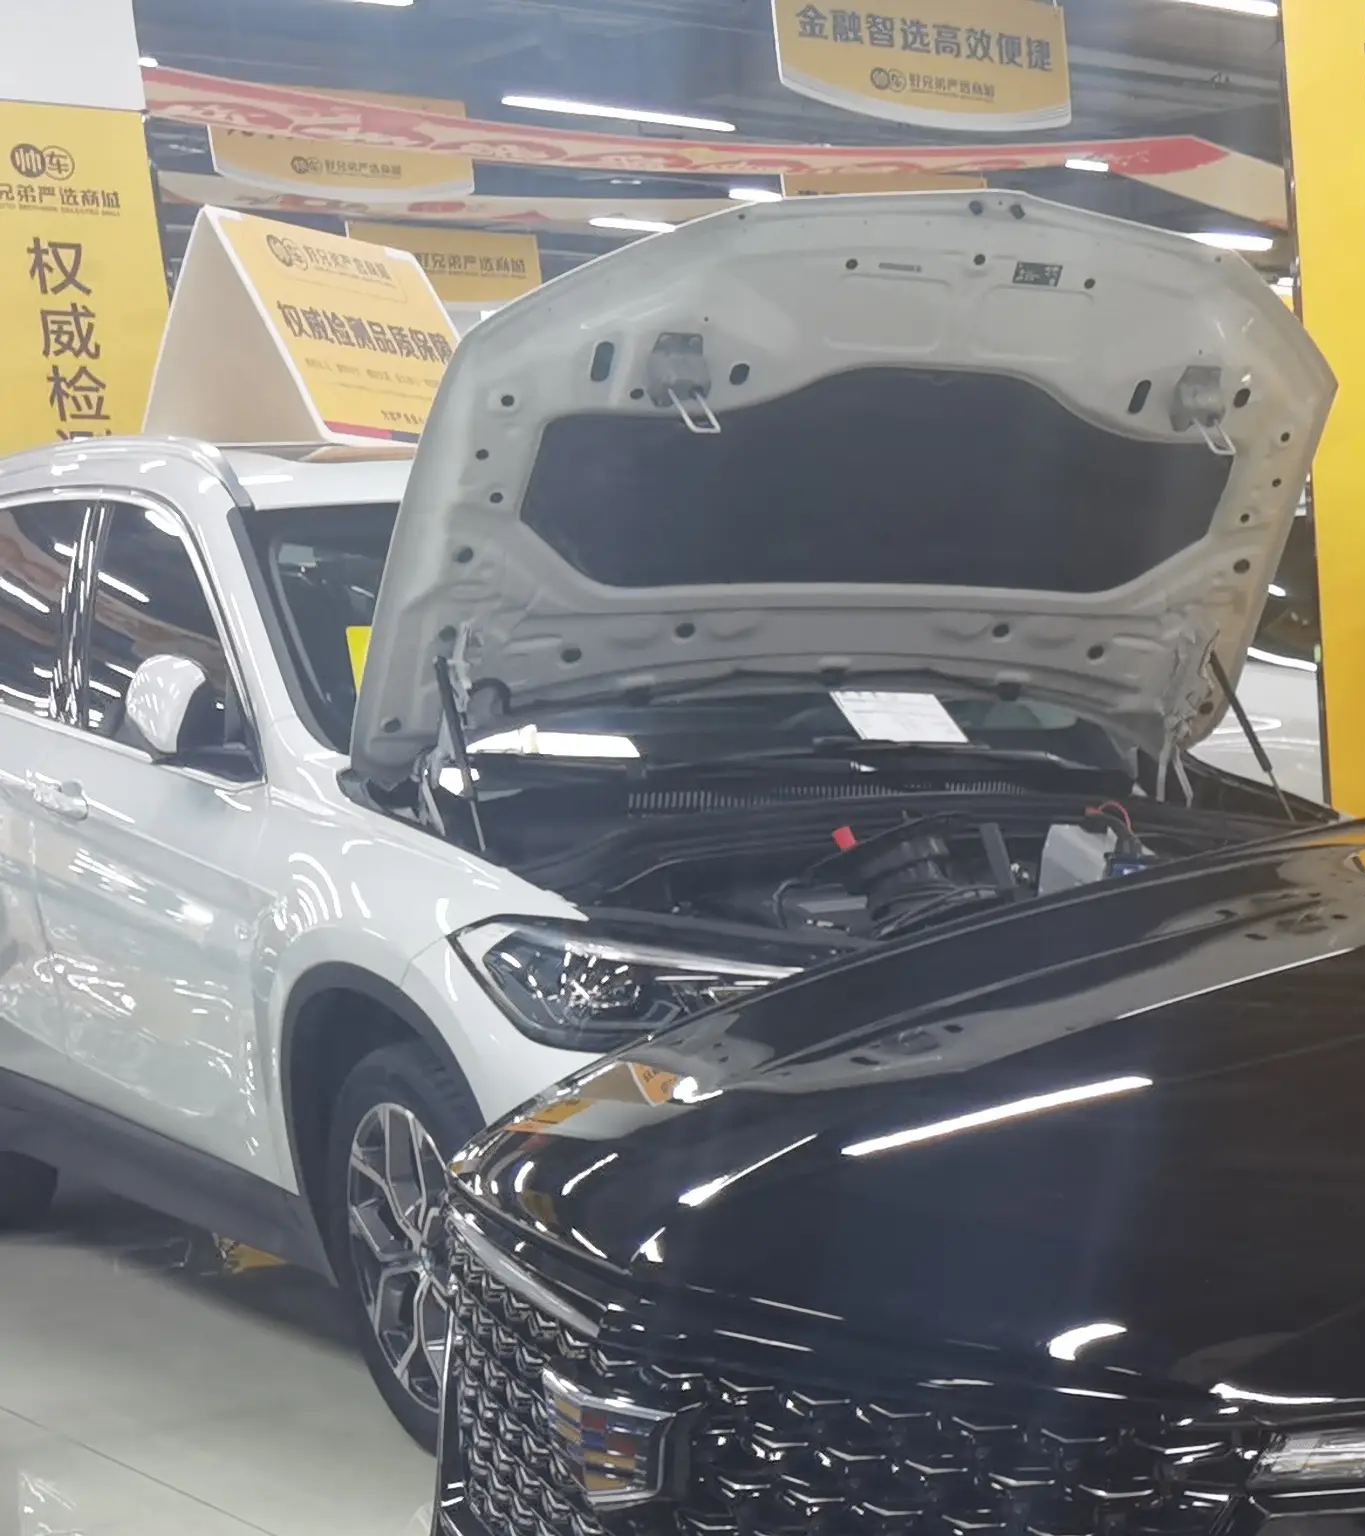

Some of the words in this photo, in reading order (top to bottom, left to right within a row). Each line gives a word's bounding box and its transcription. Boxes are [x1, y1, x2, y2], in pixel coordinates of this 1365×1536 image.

[795, 3, 1053, 72] 金融智选高效便捷
[26, 236, 111, 440] 权威检
[277, 301, 453, 365] 权威检测品质保障
